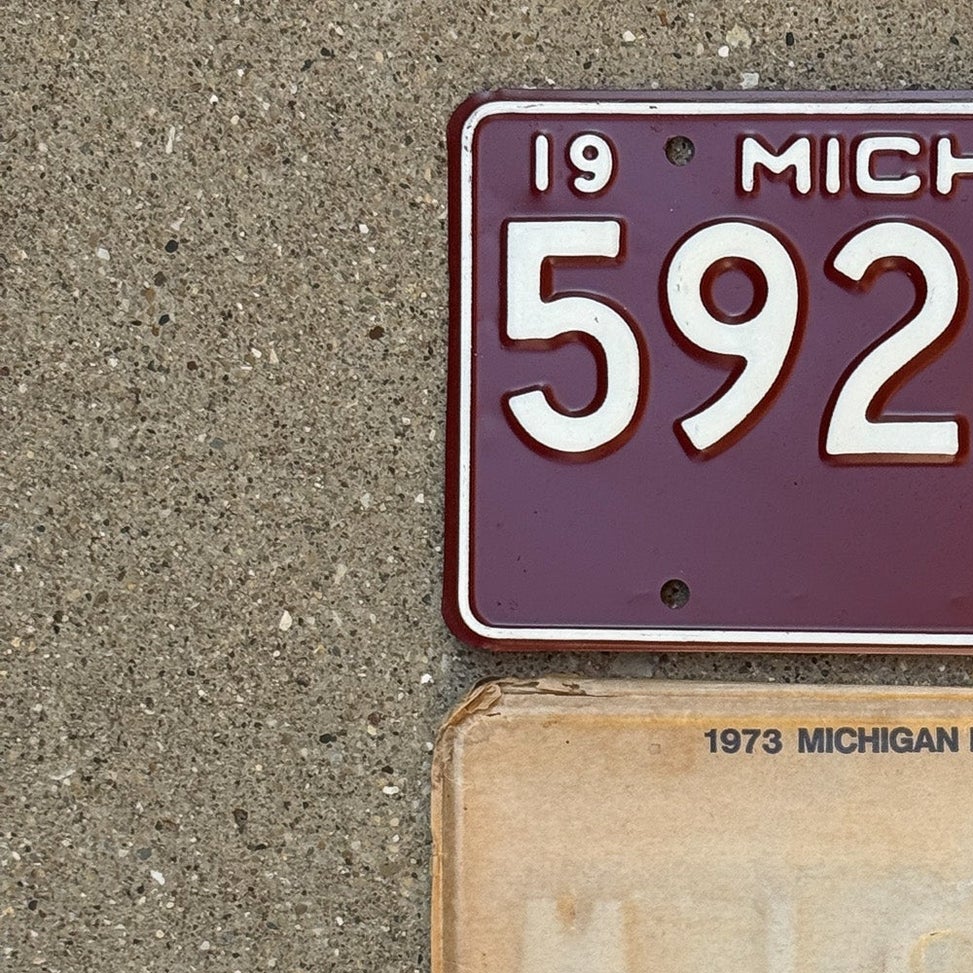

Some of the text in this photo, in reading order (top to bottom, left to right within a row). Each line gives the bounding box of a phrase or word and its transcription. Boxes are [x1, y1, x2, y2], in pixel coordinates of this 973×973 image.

[534, 132, 615, 195] 19
[703, 727, 784, 756] 1973
[797, 726, 960, 756] MICHIGAN
